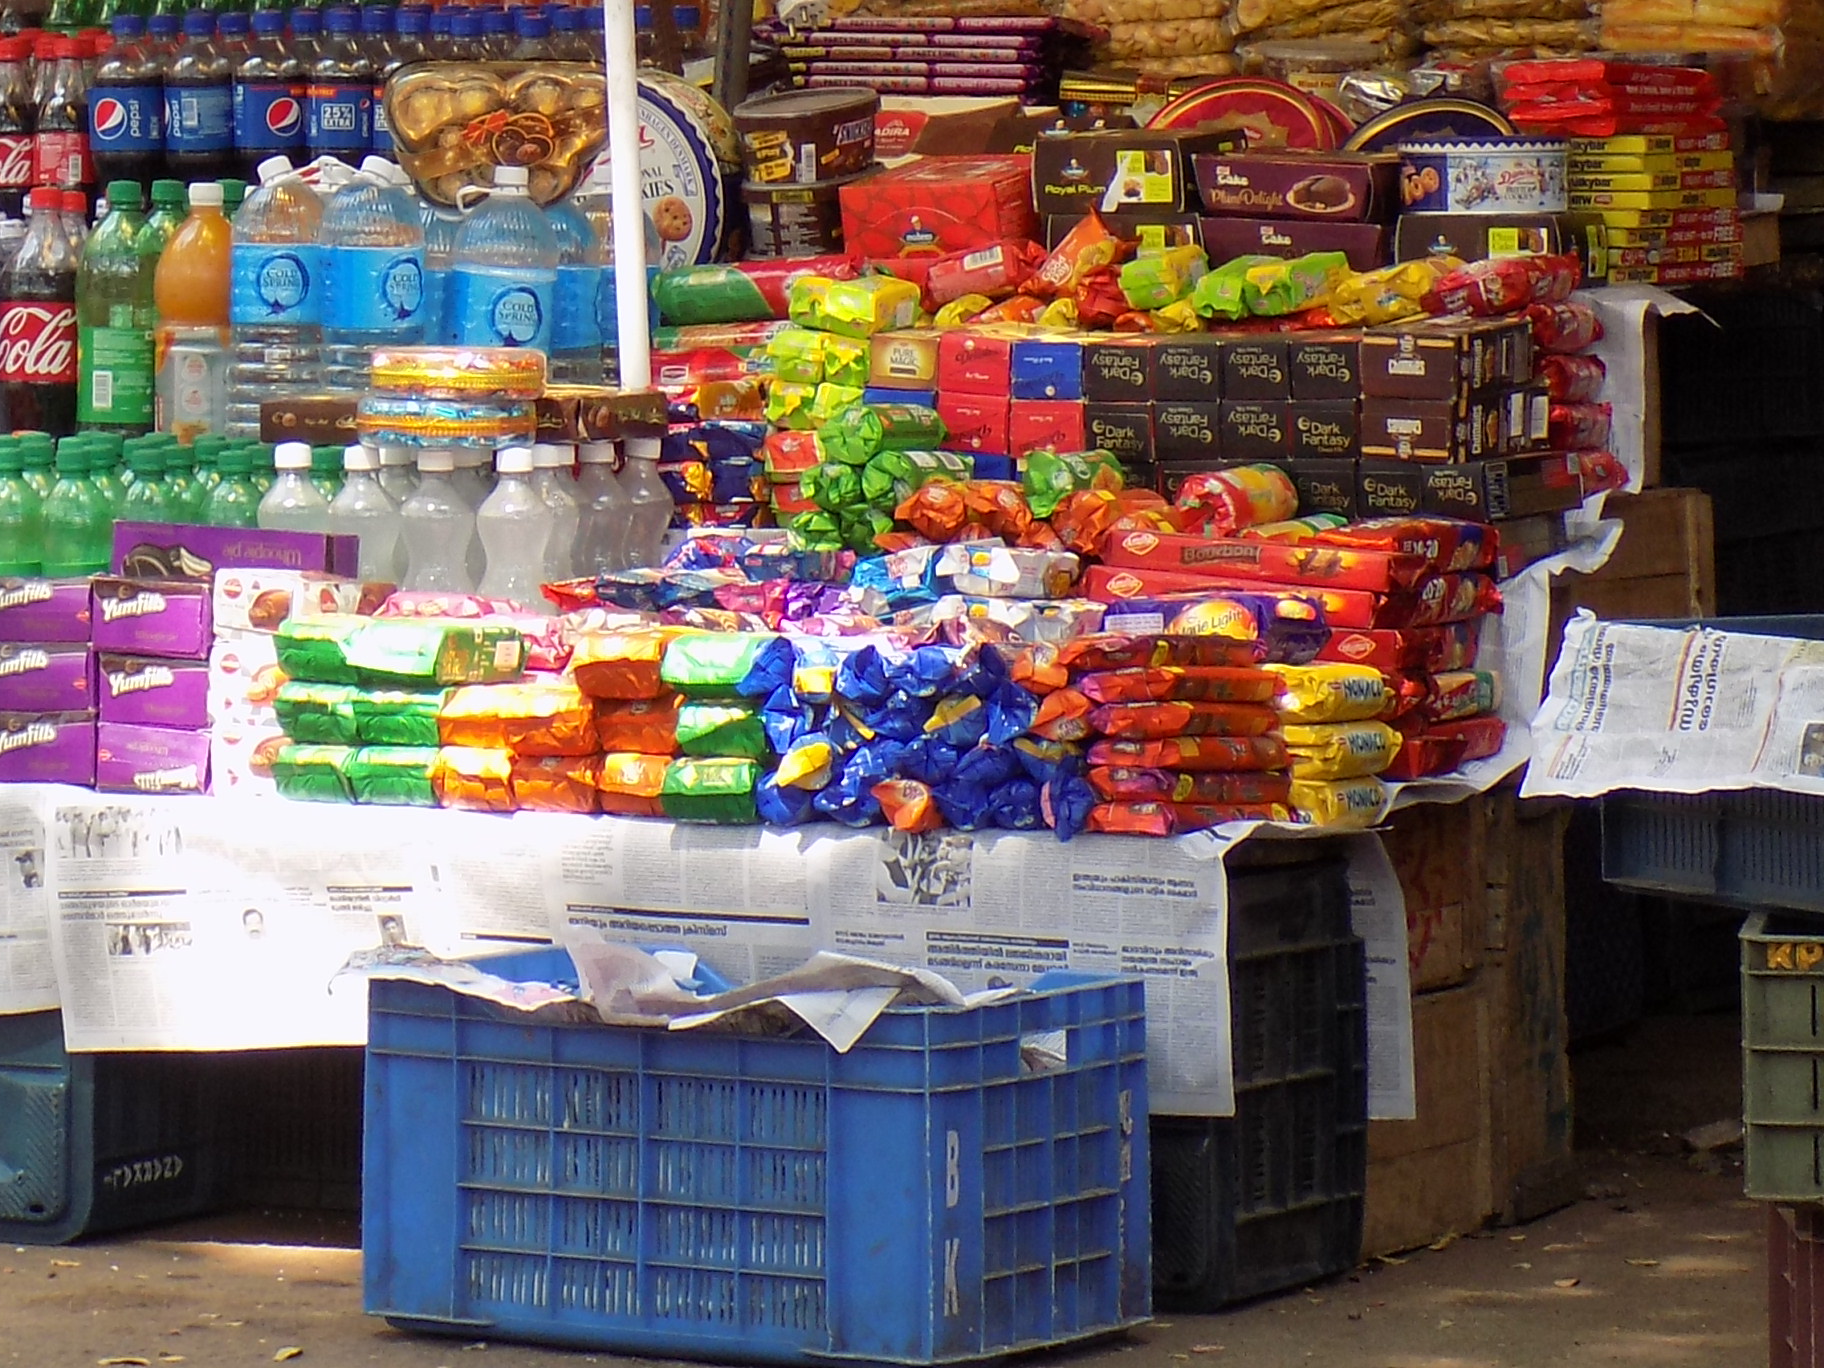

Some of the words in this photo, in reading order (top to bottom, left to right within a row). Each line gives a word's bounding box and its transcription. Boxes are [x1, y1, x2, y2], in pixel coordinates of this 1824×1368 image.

[129, 98, 141, 138] pepsi
[172, 100, 182, 138] pepsi
[322, 105, 353, 119] 25%
[322, 117, 353, 129] EXTRA
[1044, 183, 1075, 195] Royal
[1078, 183, 1107, 194] Plum
[266, 268, 298, 281] COLD
[392, 272, 419, 285] COLD
[501, 300, 535, 313] COLD
[1091, 353, 1140, 369] Fantasy
[1159, 353, 1208, 369] Fantasy
[1227, 352, 1277, 368] Fantasy
[1295, 350, 1346, 366] Fantasy
[1101, 367, 1134, 381] Dark
[1168, 366, 1201, 379] Dark
[1238, 364, 1271, 379] Dark
[1306, 364, 1339, 378] Dark
[1159, 413, 1208, 428] Fantasy
[1227, 412, 1277, 428] Fantasy
[1105, 425, 1134, 439] Dark
[1167, 424, 1201, 438] Dark
[1238, 424, 1270, 438] Dark
[1310, 421, 1340, 435] Dark
[1095, 435, 1144, 450] Fantasy
[1301, 433, 1351, 448] Fantasy
[1376, 483, 1408, 497] Dark
[1367, 493, 1418, 509] Fantasy
[101, 591, 167, 622] Yumfills
[1210, 610, 1243, 629] Light
[108, 666, 174, 698] Yumfills
